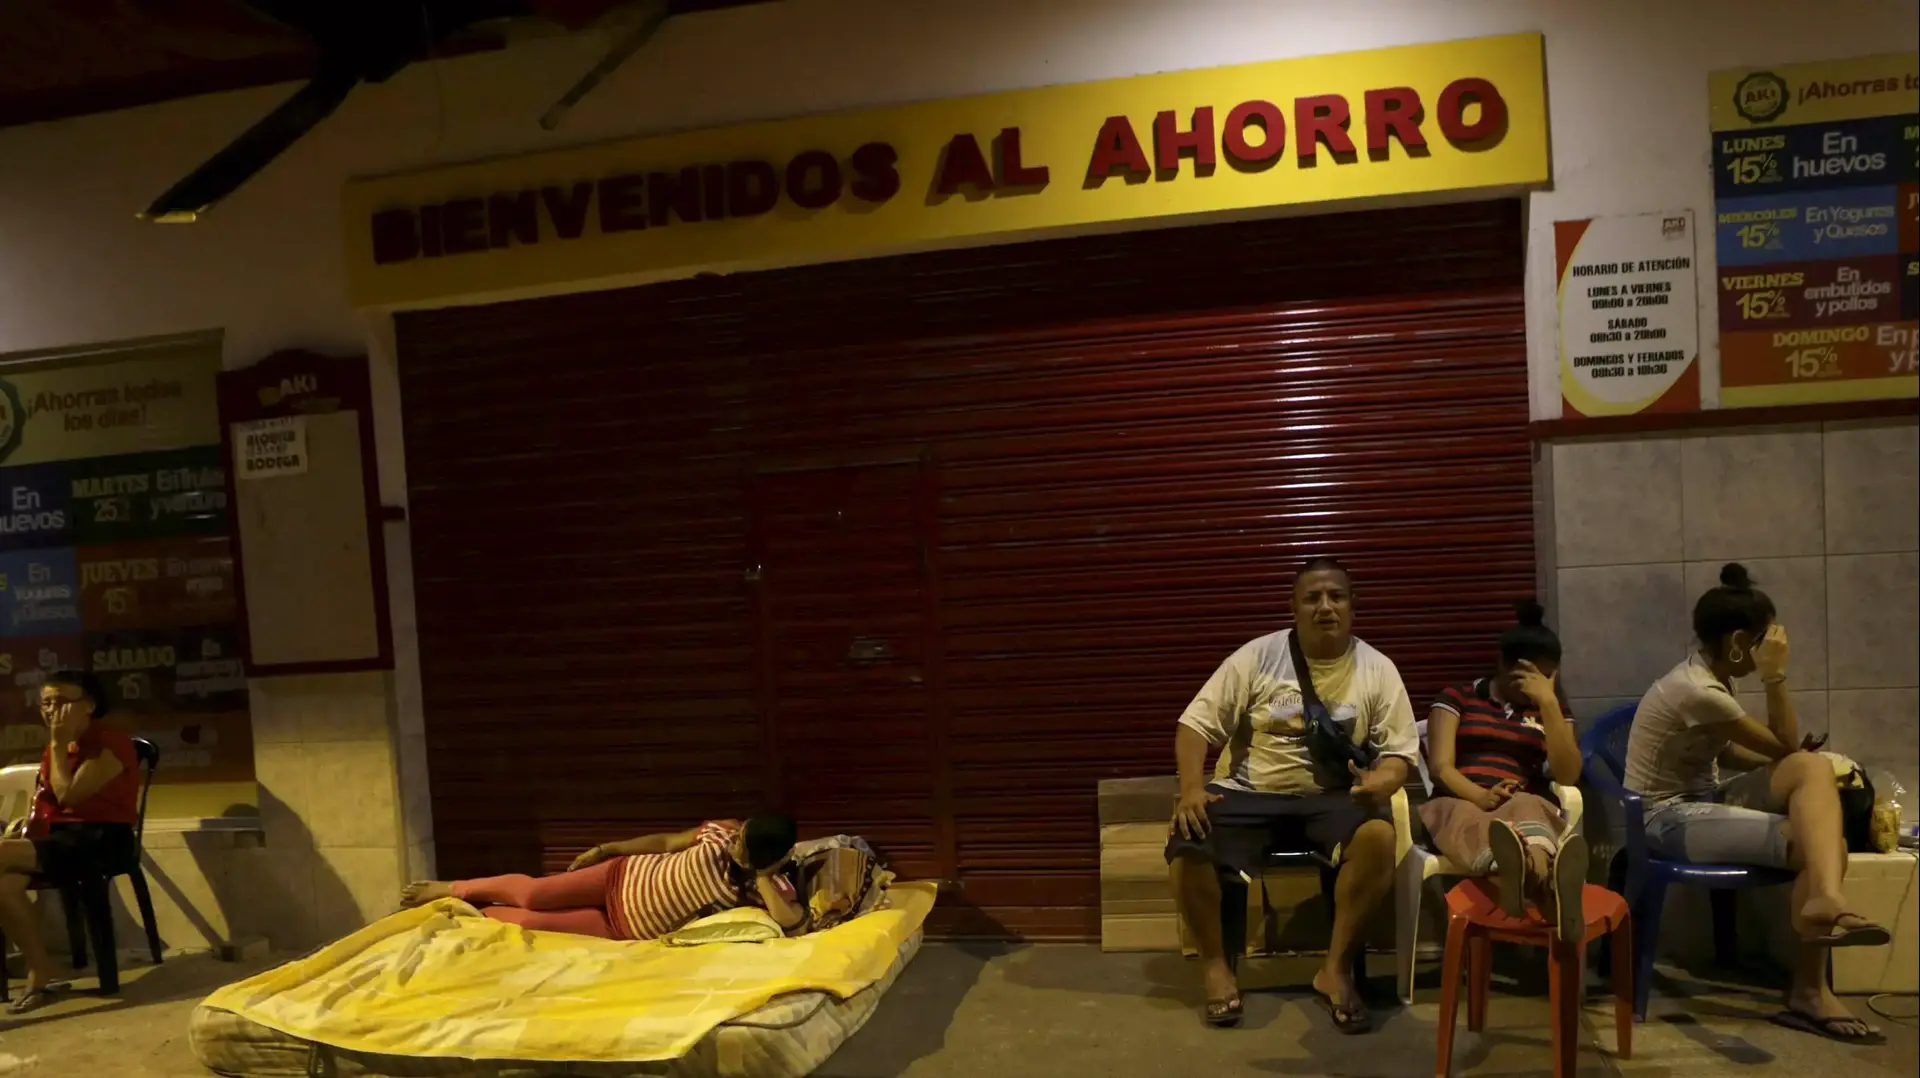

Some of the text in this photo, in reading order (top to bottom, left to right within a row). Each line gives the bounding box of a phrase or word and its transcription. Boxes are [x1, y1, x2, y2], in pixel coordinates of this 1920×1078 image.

[1722, 134, 1786, 154] LUNES
[1823, 132, 1857, 155] En
[371, 77, 1508, 265] BIENVENIDOS AL AHORRO
[1726, 152, 1778, 185] 15%
[1792, 152, 1887, 179] huevos
[1805, 206, 1827, 224] En
[1813, 227, 1824, 244] y
[1573, 257, 1690, 277] HORARIO DE ATENCIÓN
[1836, 266, 1860, 282] En
[1587, 281, 1672, 298] LUNES A VIERNES
[1721, 271, 1805, 291] VIERNES
[1804, 279, 1892, 301] embutidos
[1736, 289, 1787, 320] 15%
[1814, 296, 1879, 318] y pollos
[1772, 325, 1870, 348] DOMINGO
[1876, 326, 1907, 346] En
[1574, 350, 1684, 368] DOMINGOS Y FERIADOS
[1784, 345, 1839, 378] 15%
[1888, 351, 1905, 373] y
[64, 412, 93, 432] los
[12, 486, 41, 511] En
[28, 563, 50, 583] En
[81, 558, 159, 588] JUEVES
